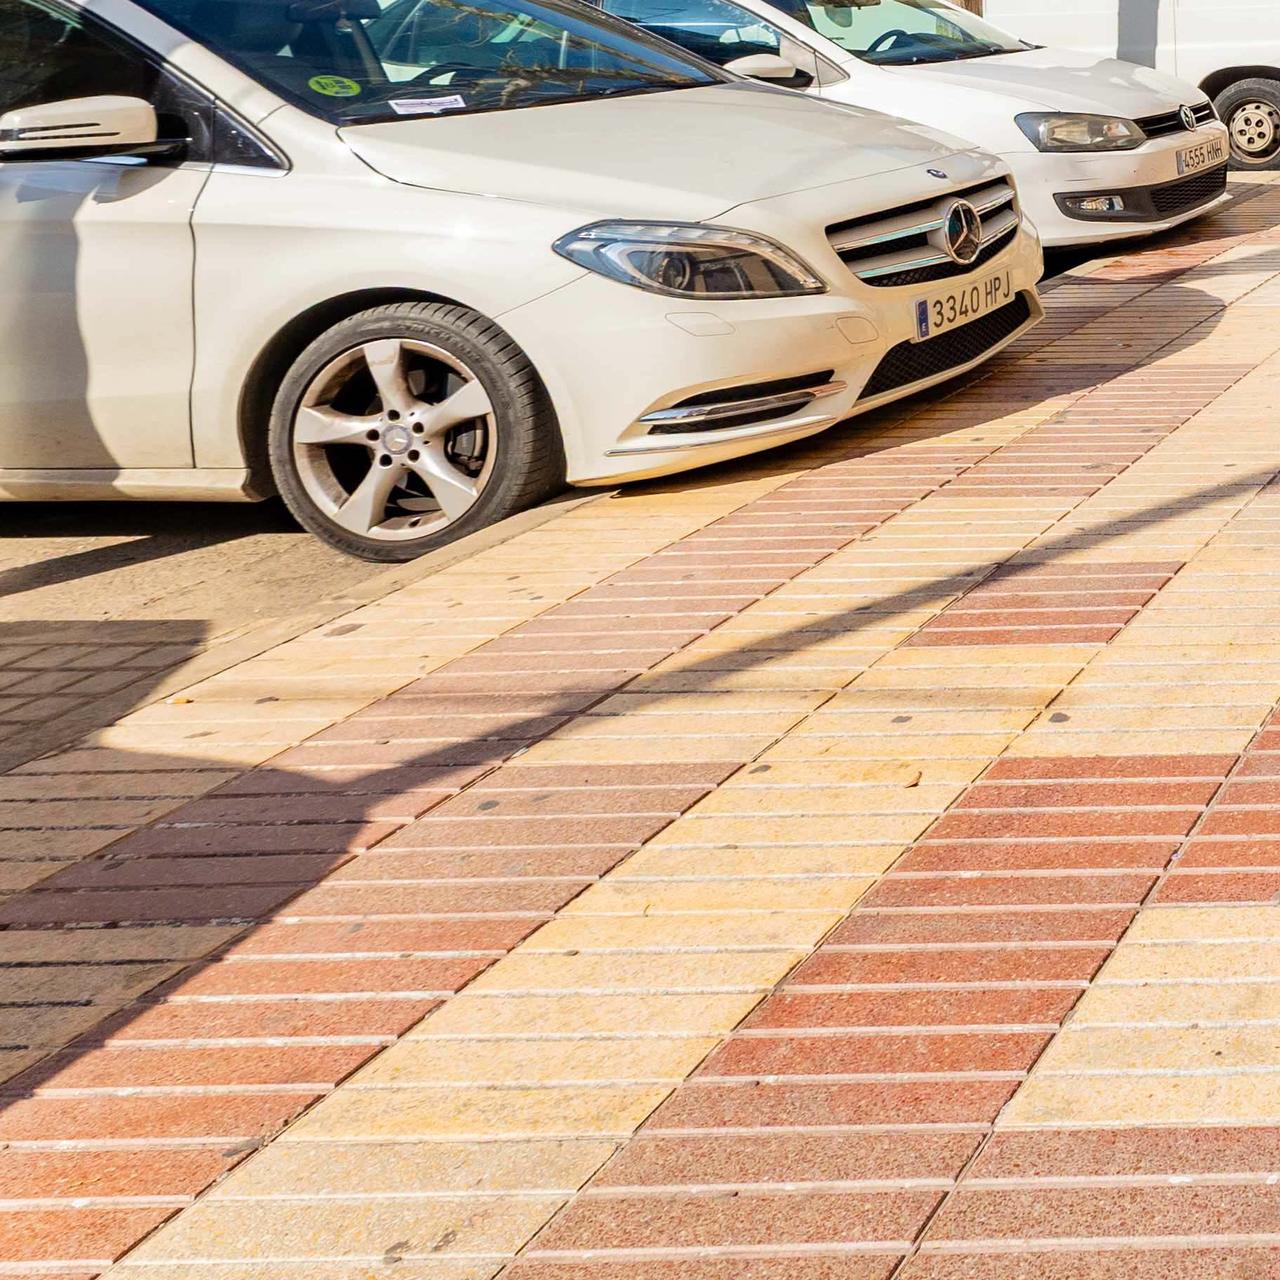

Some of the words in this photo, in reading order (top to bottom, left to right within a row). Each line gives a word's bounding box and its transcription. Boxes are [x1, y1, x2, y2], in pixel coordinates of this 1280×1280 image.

[1184, 146, 1206, 169] 4555
[933, 286, 980, 328] 3340
[984, 270, 1010, 308] HPJ
